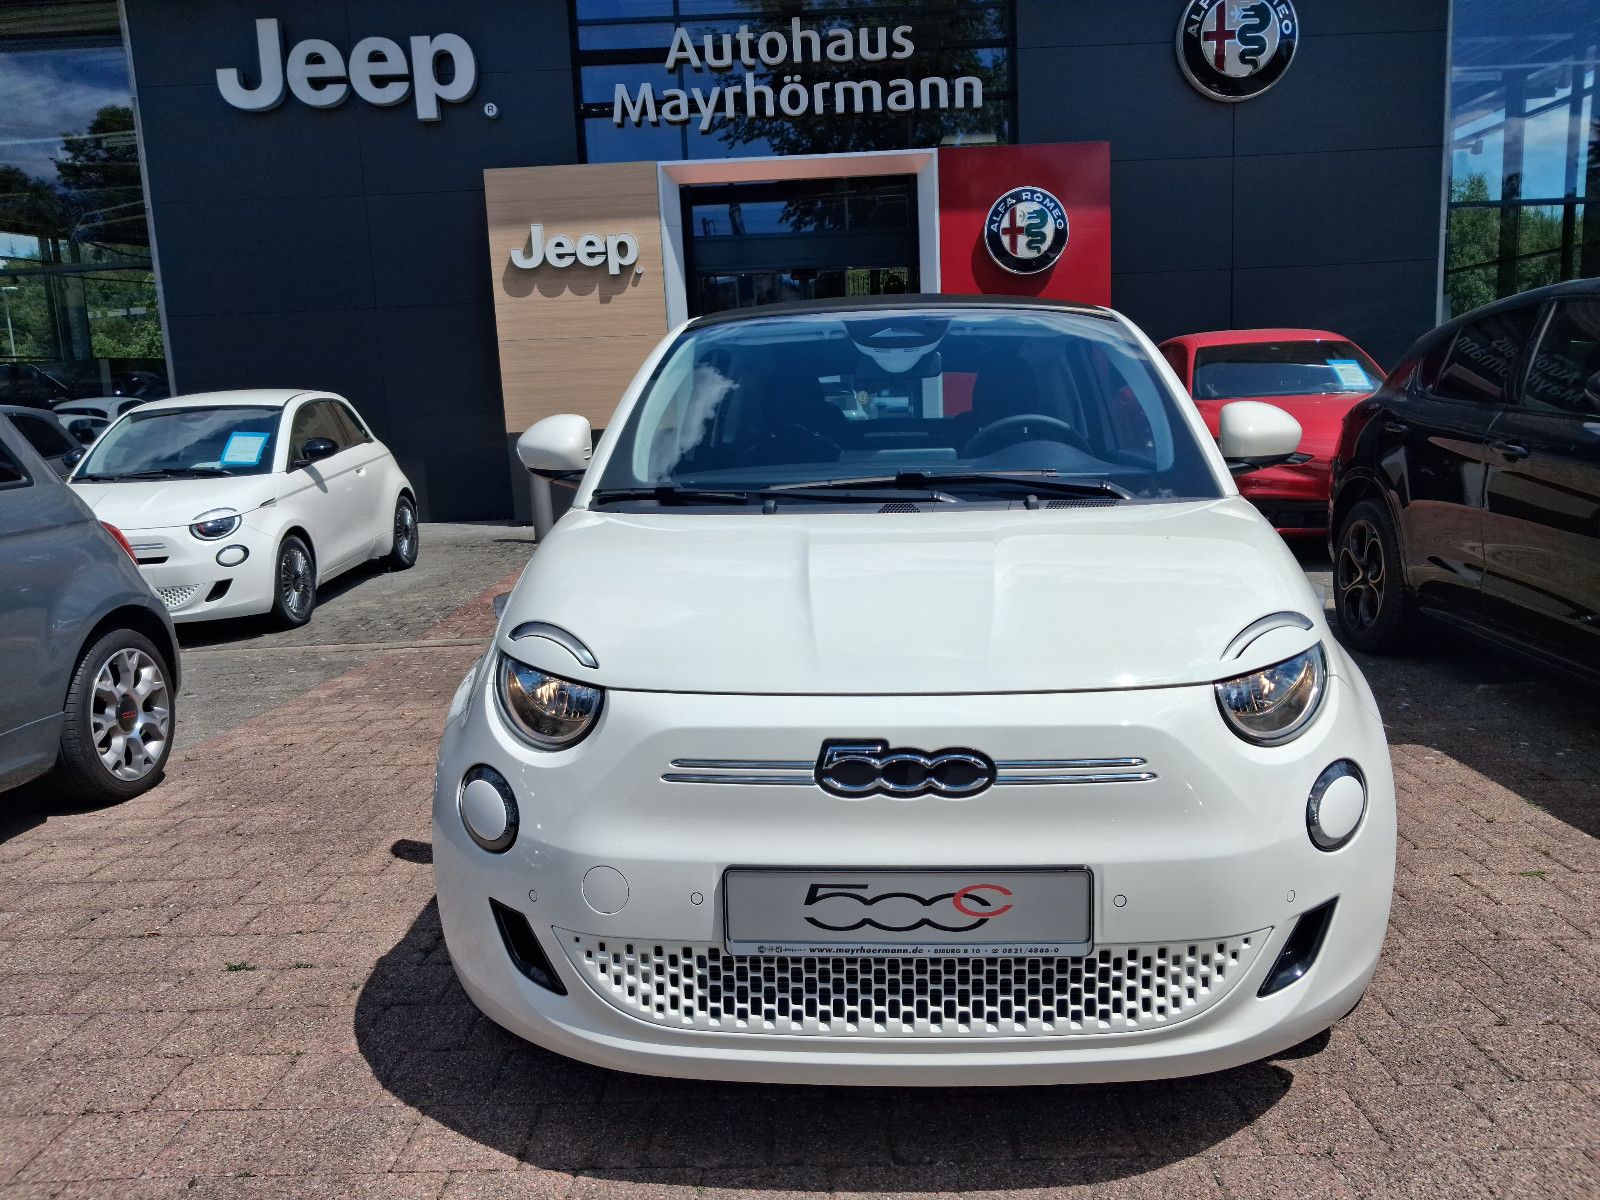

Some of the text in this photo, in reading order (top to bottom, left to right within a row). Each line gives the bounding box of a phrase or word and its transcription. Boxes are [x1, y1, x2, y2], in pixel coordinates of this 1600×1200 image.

[665, 17, 915, 69] Autohaus
[1187, 0, 1211, 37] ALF
[216, 18, 478, 121] Jeep
[612, 73, 983, 132] Mayrhörmann
[991, 192, 1064, 232] ALFA ROMEO
[511, 224, 639, 275] Jeep
[821, 744, 990, 793] 500
[809, 945, 924, 955] www.mayrhoermann.de
